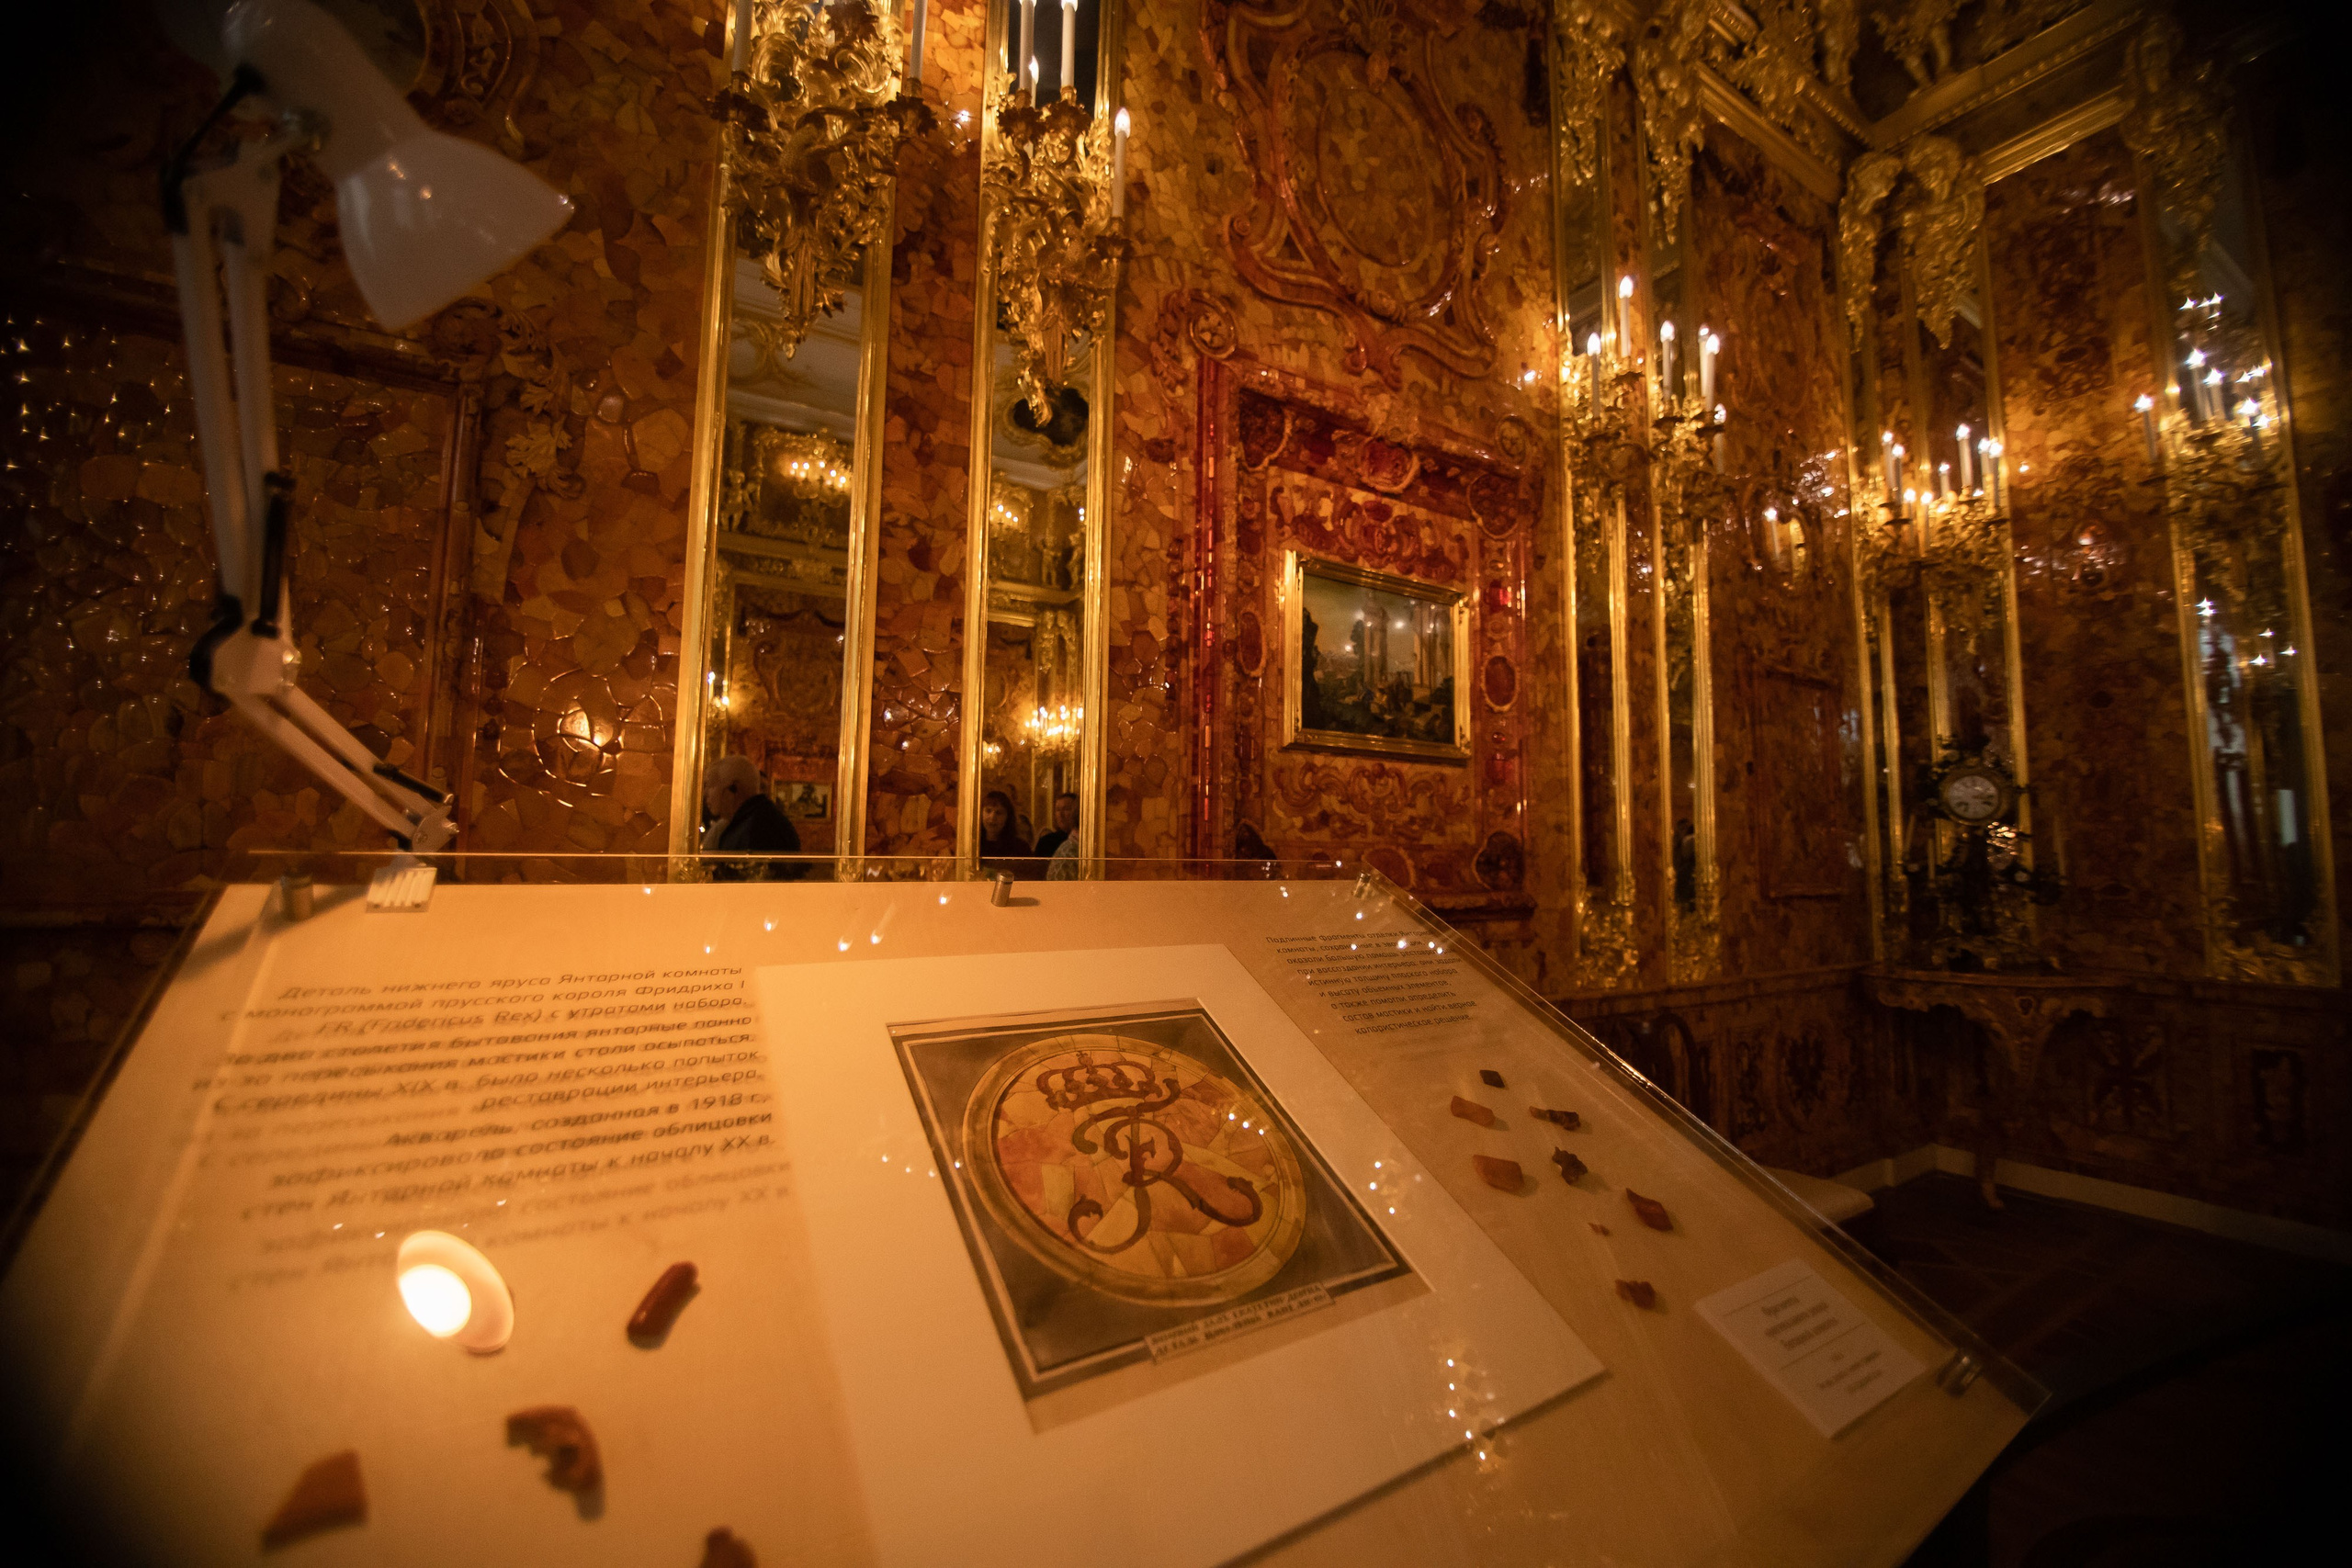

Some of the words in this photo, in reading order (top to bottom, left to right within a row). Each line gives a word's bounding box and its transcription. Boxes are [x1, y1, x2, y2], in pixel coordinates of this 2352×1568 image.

[1286, 956, 1323, 964] оказали
[1325, 953, 1364, 962] большую
[1316, 964, 1373, 974] воссоздании
[278, 987, 371, 1001] Деталь
[381, 980, 481, 993] нижнего
[490, 976, 550, 991] яруса
[558, 969, 655, 987] Янтарной
[662, 966, 742, 979] комнаты
[1307, 977, 1351, 986] истинную
[1352, 974, 1391, 982] толщину
[1430, 968, 1458, 976] набора
[244, 998, 423, 1020] монограммой
[431, 992, 544, 1010] прусского
[552, 988, 627, 1003] короля
[635, 982, 733, 998] Фридриха
[1328, 988, 1361, 998] высоту
[1339, 1000, 1368, 1009] также
[1370, 996, 1406, 1005] помогли
[1408, 992, 1456, 1001] определить
[493, 1008, 543, 1026] Rex)
[550, 1010, 560, 1020] с
[567, 1000, 666, 1020] утратами
[673, 995, 749, 1010] набора.
[1342, 1012, 1374, 1021] состав
[1375, 1009, 1413, 1018] мастики
[1421, 1004, 1447, 1012] найти
[1447, 1000, 1477, 1010] верное
[322, 1039, 442, 1058] столетия
[447, 1030, 578, 1050] бытования
[584, 1021, 687, 1041] янтарные
[694, 1015, 752, 1029] панно
[1354, 1018, 1432, 1035] колористическое
[467, 1049, 567, 1067] мастики
[574, 1043, 636, 1058] стали
[395, 1078, 436, 1095] XIX
[476, 1070, 538, 1089] было
[546, 1058, 665, 1082] несколько
[673, 1048, 759, 1069] попыток
[477, 1081, 639, 1112] реставрации
[530, 1105, 661, 1131] созданная
[663, 1102, 680, 1115] в
[690, 1092, 743, 1112] 1918
[513, 1128, 645, 1158] состояние
[652, 1111, 773, 1139] облицовки
[481, 1161, 599, 1190] комнаты
[629, 1143, 716, 1167] началу
